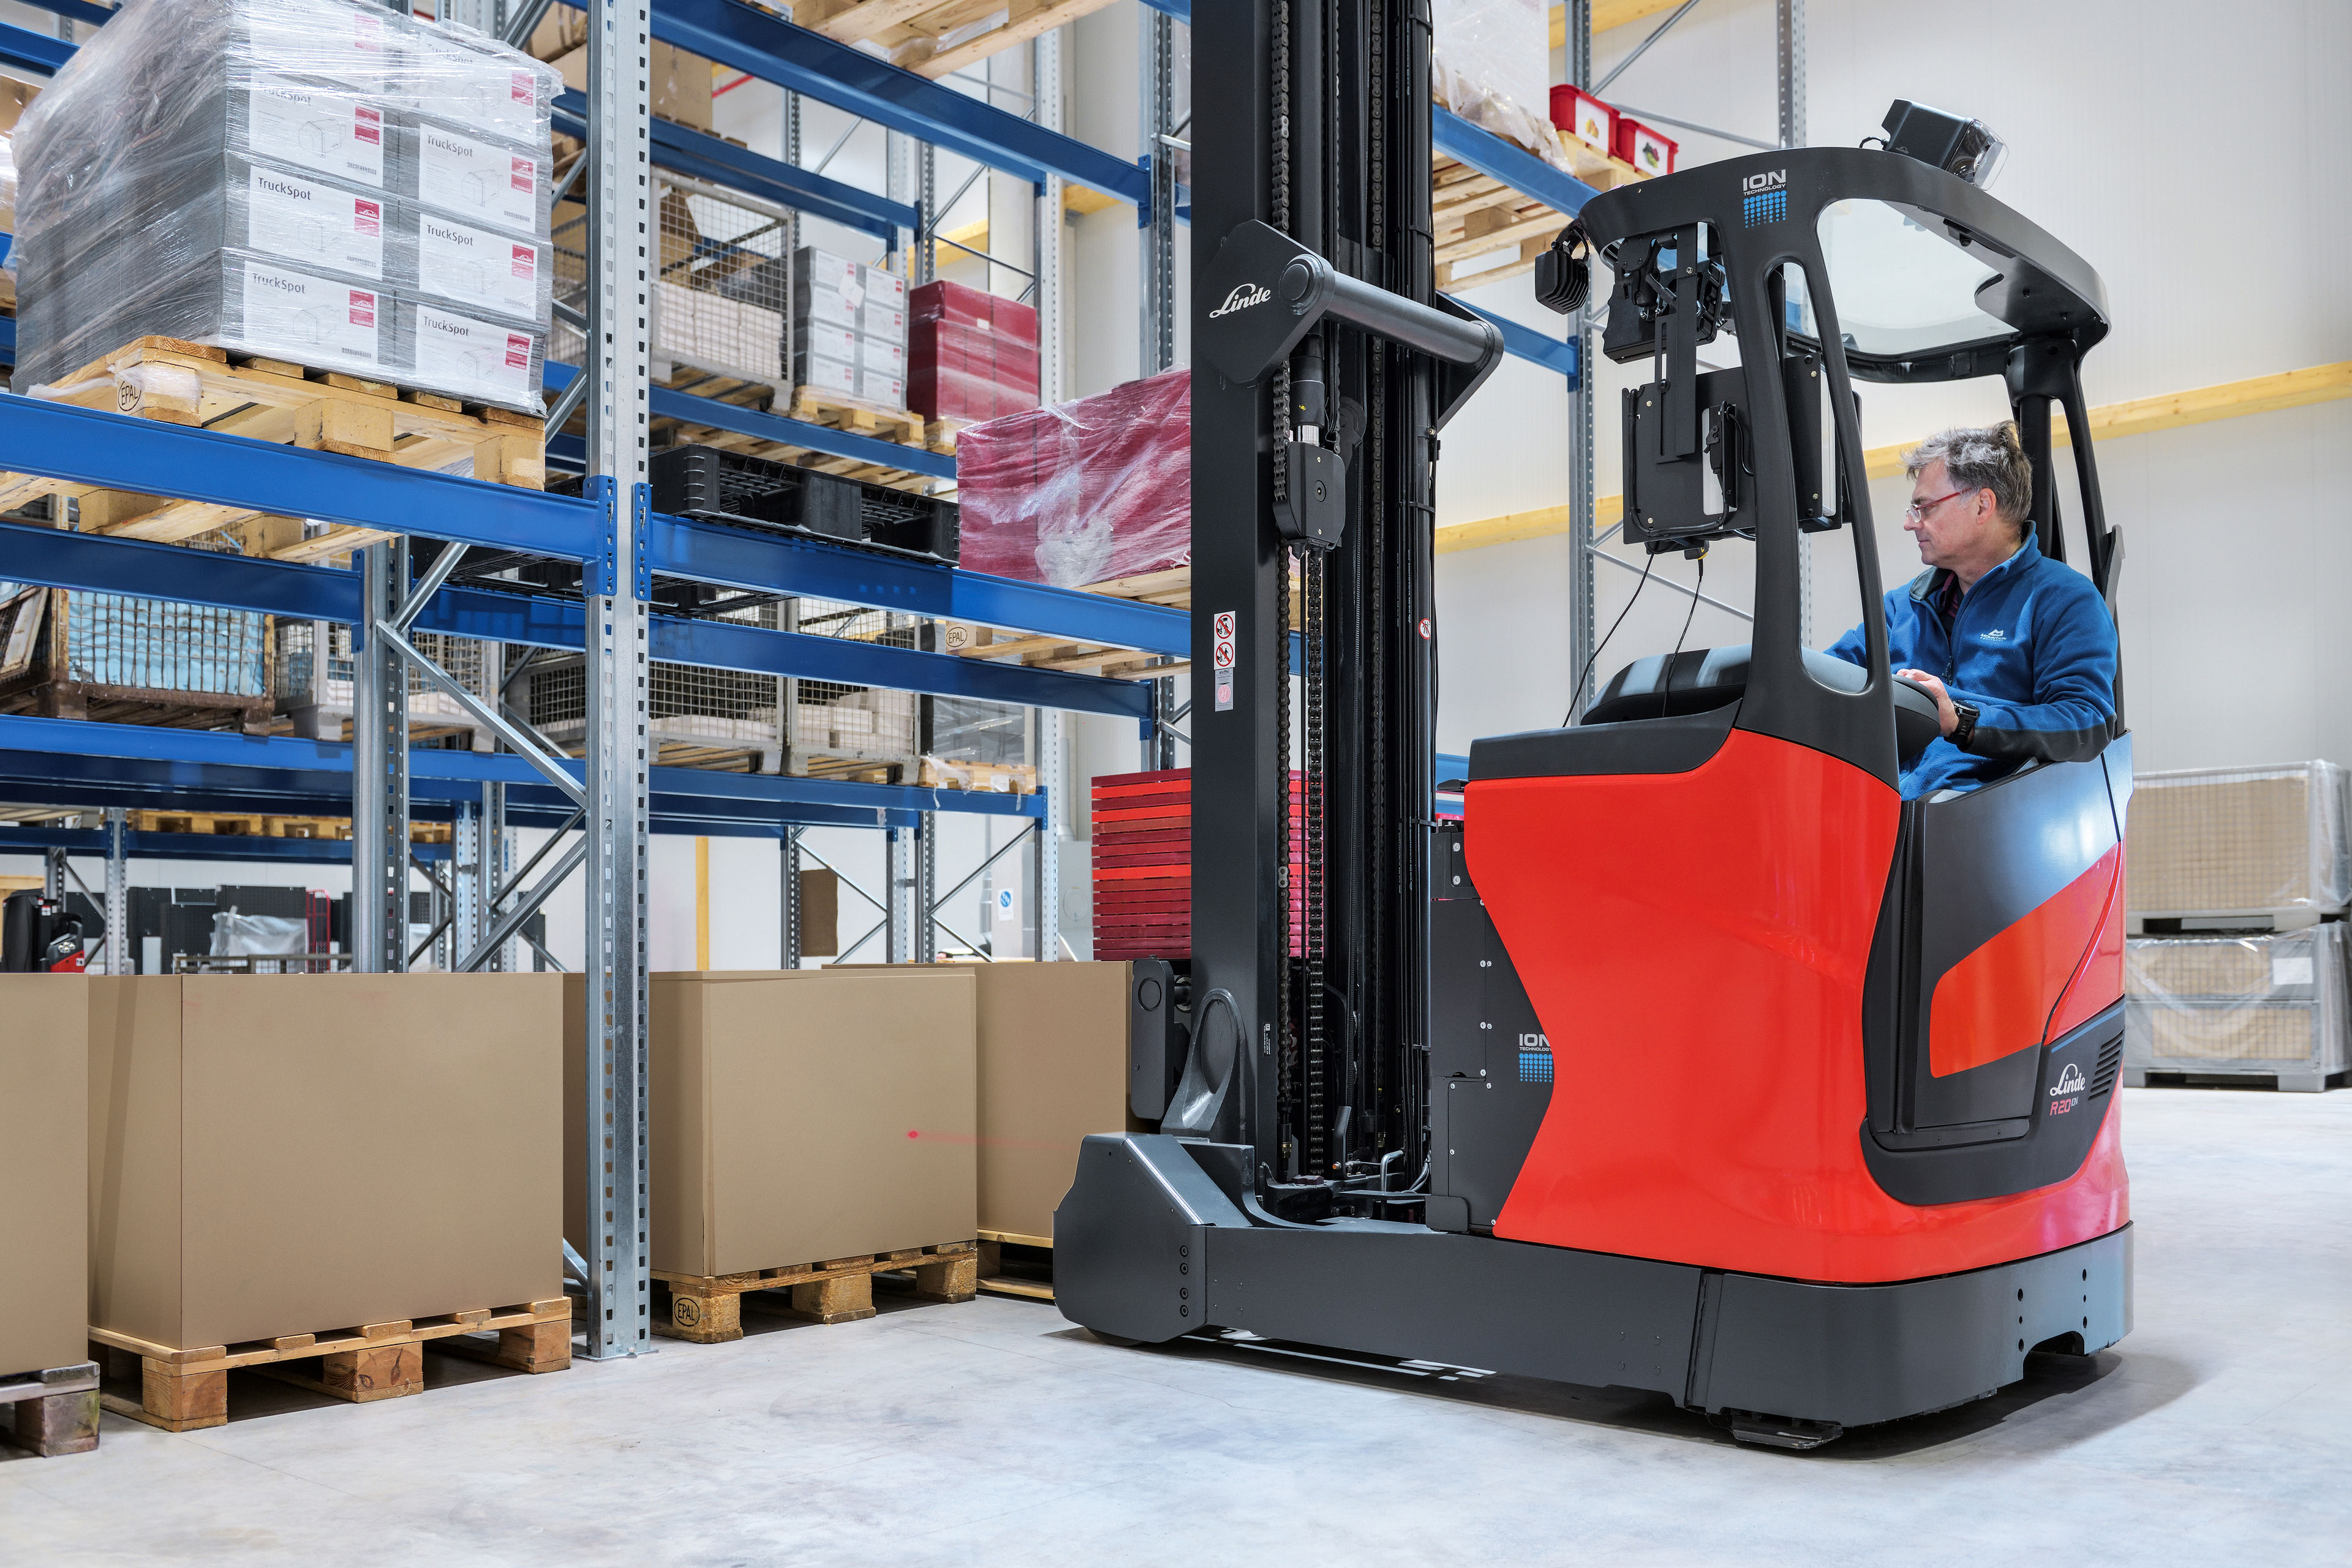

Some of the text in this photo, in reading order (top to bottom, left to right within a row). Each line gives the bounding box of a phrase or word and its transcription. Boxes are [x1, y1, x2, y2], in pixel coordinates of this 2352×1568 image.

[428, 135, 473, 157] TruckSpot
[258, 177, 311, 200] TruckSpot
[1743, 169, 1787, 191] ION
[1743, 183, 1786, 196] TECHNOLOGY
[359, 209, 378, 218] Linde
[427, 225, 473, 246] TruckSpot
[516, 254, 533, 263] Linde
[252, 273, 305, 294] TruckSpot
[353, 300, 373, 309] Linde
[1209, 283, 1271, 318] Linde
[423, 316, 469, 337] TruckSpot
[121, 385, 138, 406] EPAL
[949, 631, 964, 644] EPAL
[2049, 1063, 2086, 1096] Linde
[678, 1303, 695, 1321] EPAL
